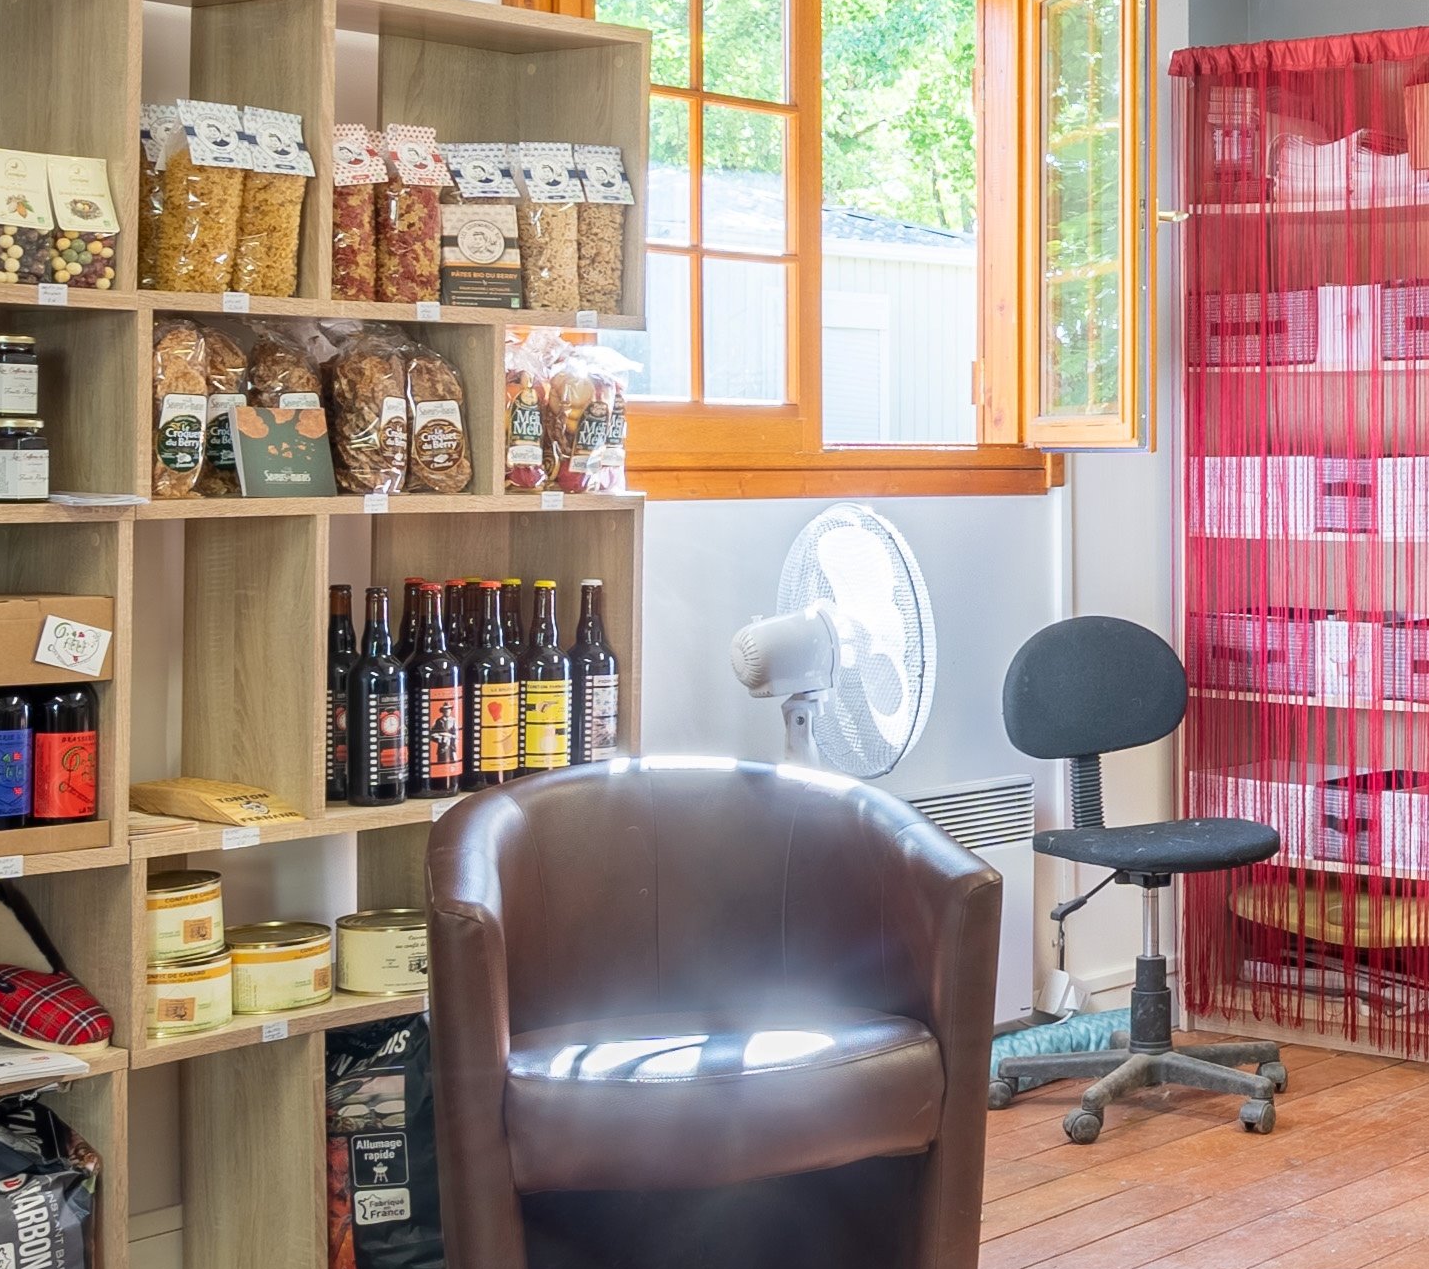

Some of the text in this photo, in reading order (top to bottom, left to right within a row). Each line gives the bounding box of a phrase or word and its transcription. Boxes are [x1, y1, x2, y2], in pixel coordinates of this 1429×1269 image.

[178, 437, 200, 450] Berry
[355, 1137, 403, 1151] Allumage
[364, 1148, 395, 1162] rapide
[46, 1191, 63, 1245] INSTANT
[370, 1207, 405, 1219] France
